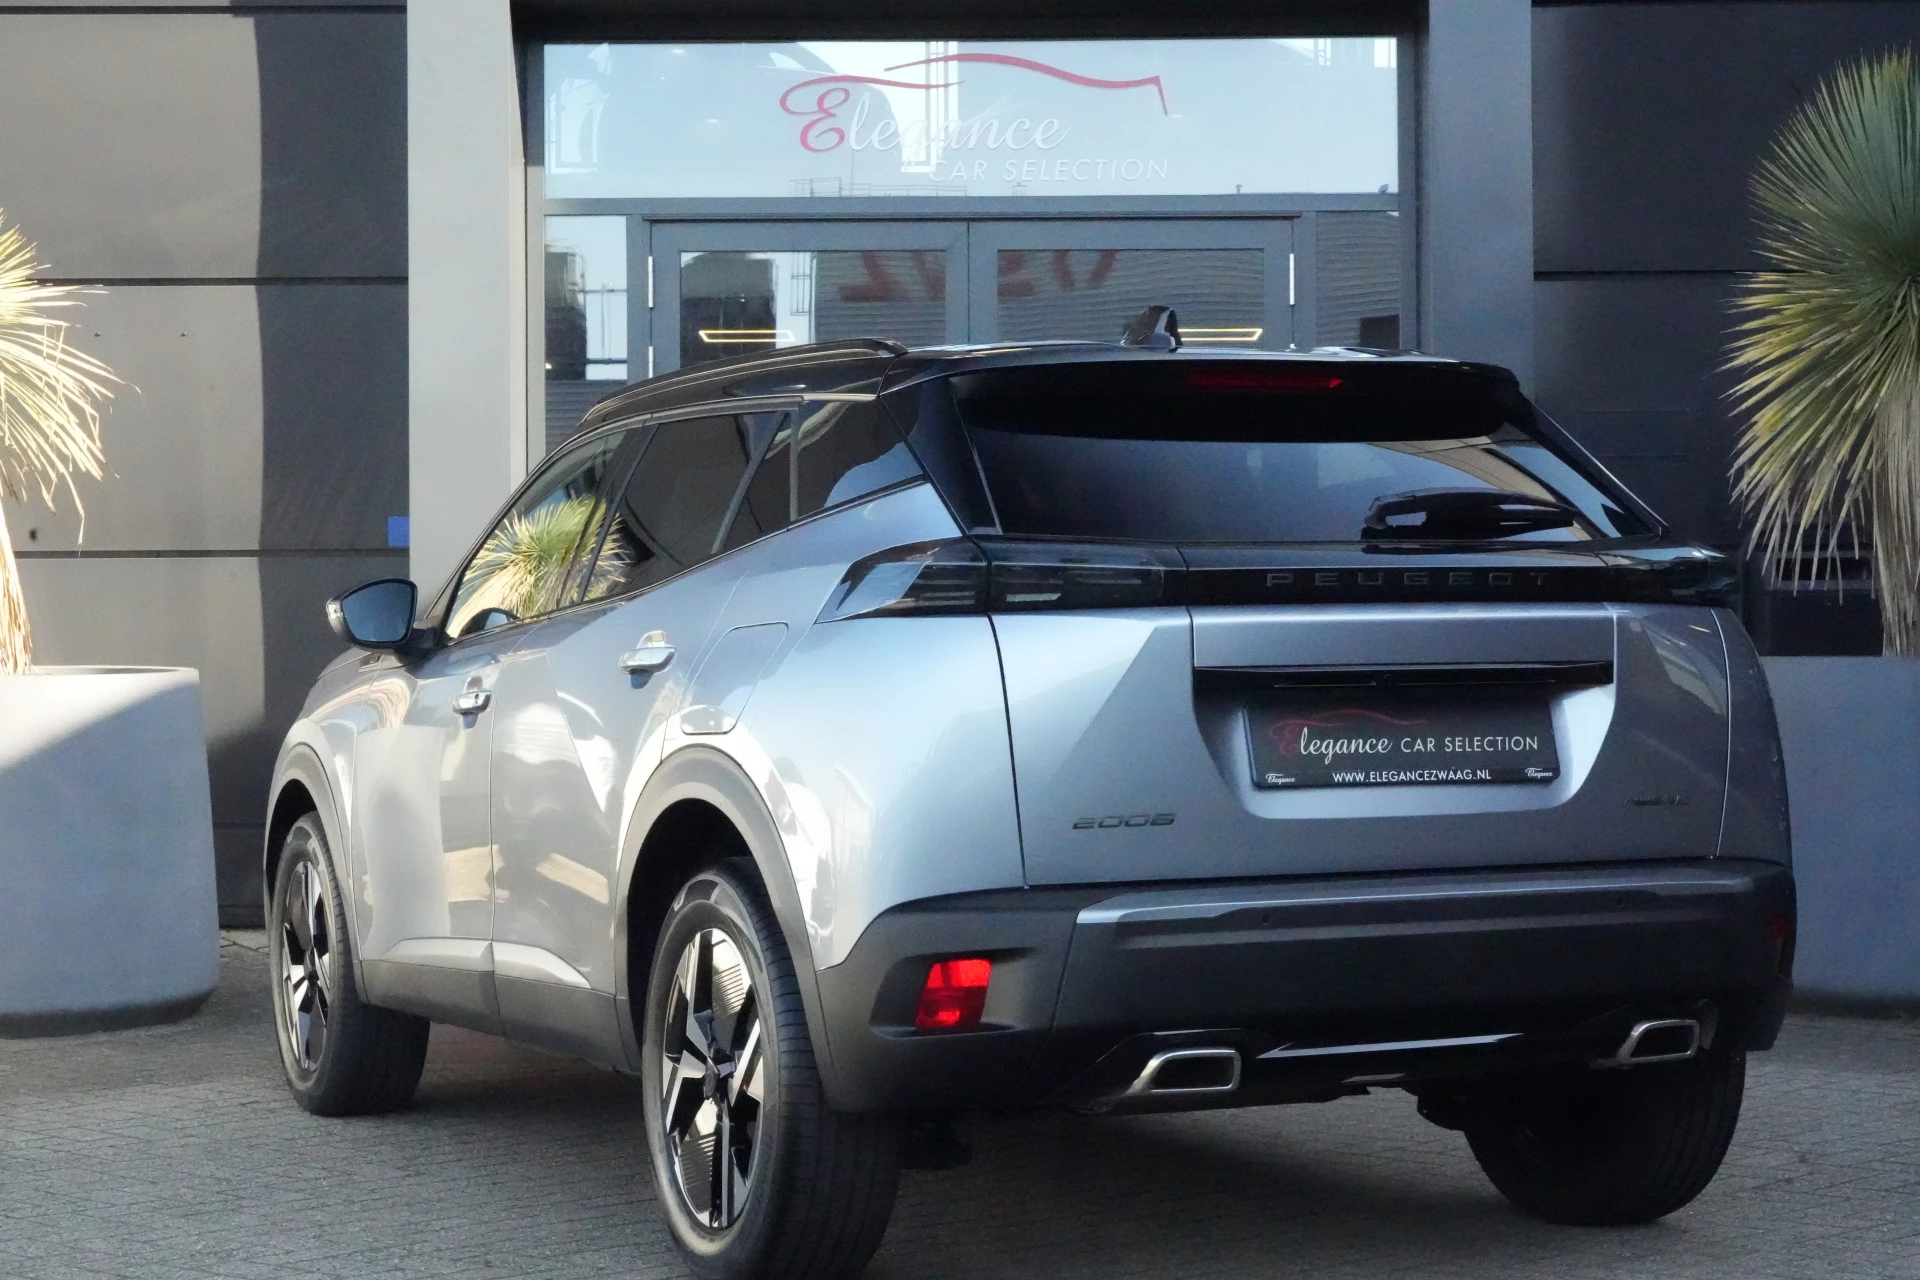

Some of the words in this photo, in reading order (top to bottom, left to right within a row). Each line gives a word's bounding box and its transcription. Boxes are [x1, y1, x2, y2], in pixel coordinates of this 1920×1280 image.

[780, 75, 1071, 167] Elegance
[929, 159, 987, 182] CAR
[1003, 158, 1169, 182] SELECTION
[1266, 571, 1550, 587] PEUGEOT
[1400, 736, 1436, 753] CAR
[1444, 735, 1538, 752] SELECTION
[1332, 768, 1492, 783] WWW.ELEGANCEZWAAG.NL
[1072, 813, 1177, 830] 2008
